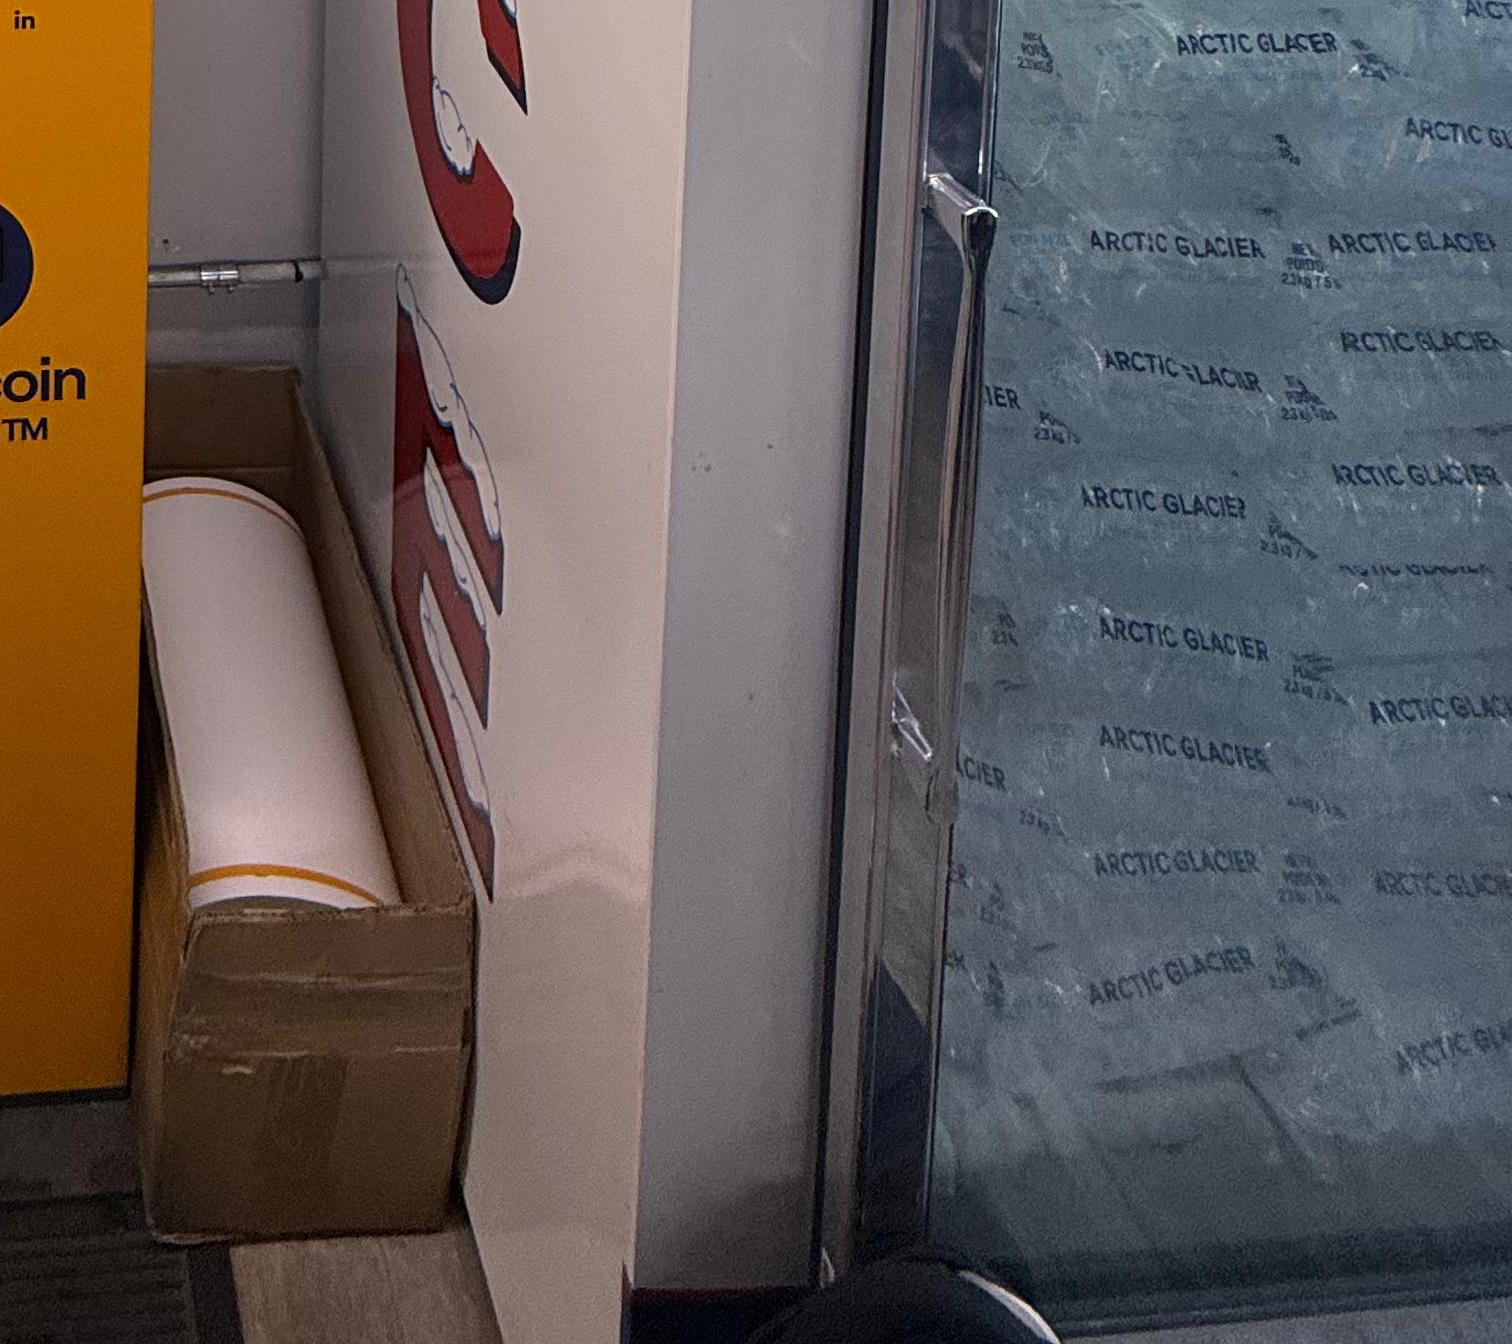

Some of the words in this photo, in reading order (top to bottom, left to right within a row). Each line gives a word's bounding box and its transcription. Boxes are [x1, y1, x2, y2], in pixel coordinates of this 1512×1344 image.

[1176, 33, 1254, 56] ARCTIC
[1405, 116, 1483, 145] ARCTIC
[1090, 229, 1167, 254] ARCTIC
[1175, 235, 1266, 260] GLACIER
[1328, 231, 1412, 254] ARCTIC
[1081, 483, 1157, 513] ARCTIC
[1099, 614, 1180, 650] ARCTIC
[1183, 626, 1270, 663] GLACIER
[1369, 696, 1447, 725] ARCTIC
[1099, 724, 1178, 758] ARCTIC
[1093, 851, 1171, 878] ARCTIC
[1174, 848, 1261, 875] GLACIER
[1088, 965, 1165, 1006] ARCTIC
[1163, 945, 1257, 986] GLACIER
